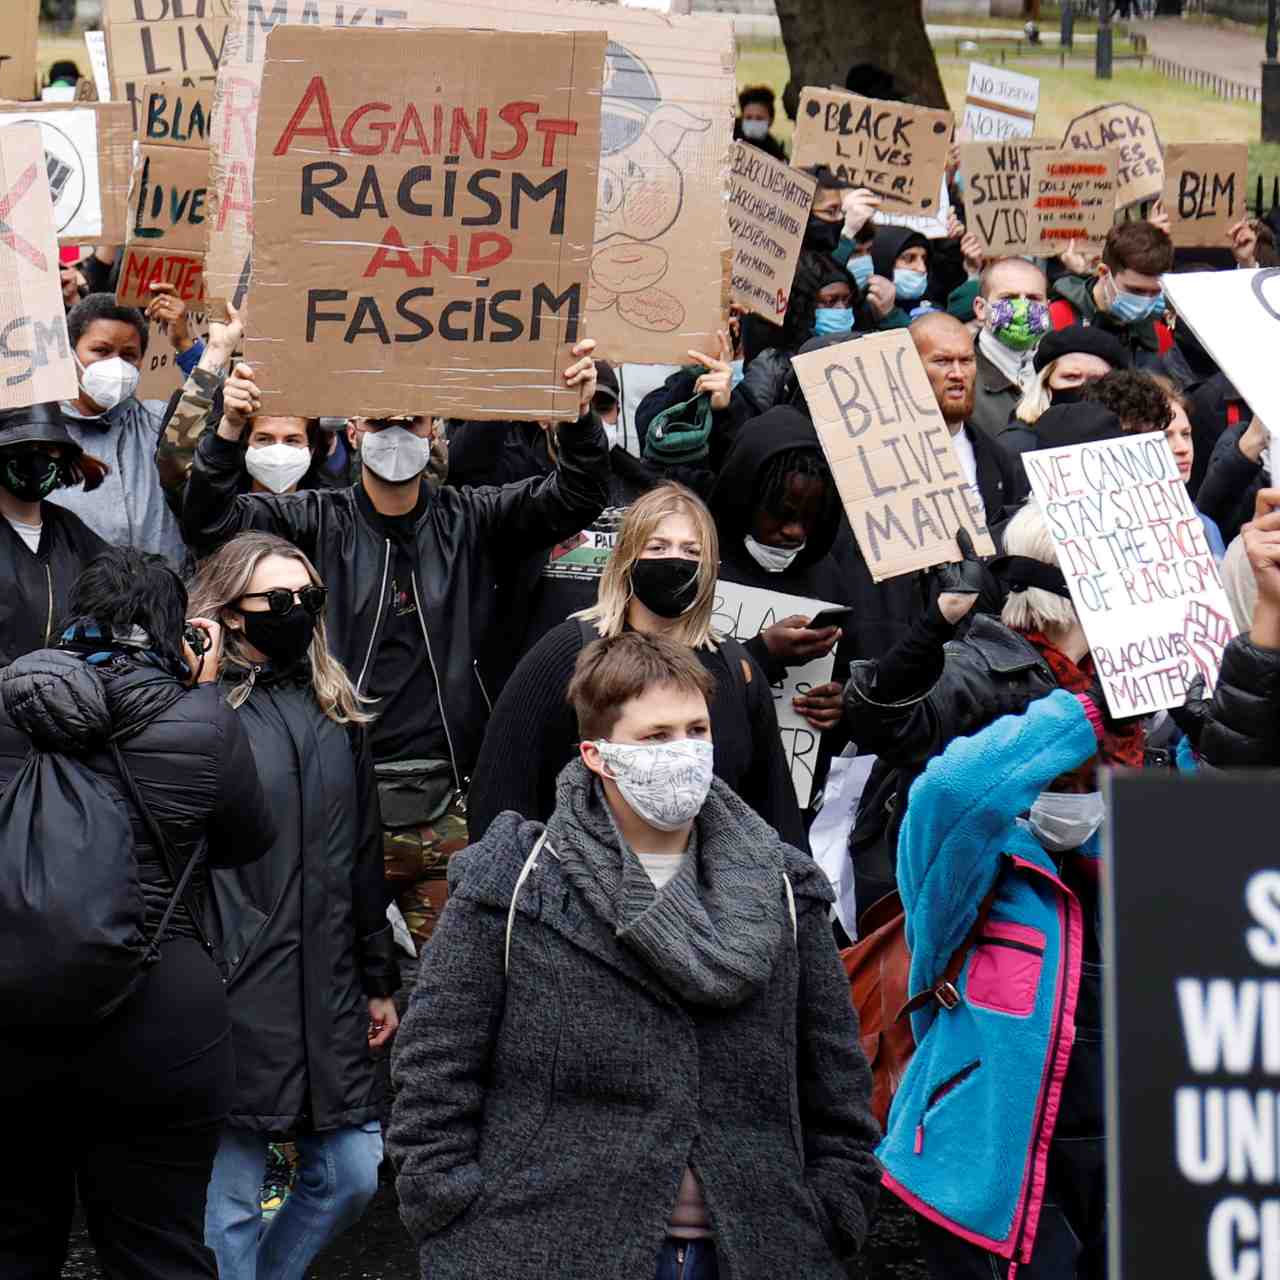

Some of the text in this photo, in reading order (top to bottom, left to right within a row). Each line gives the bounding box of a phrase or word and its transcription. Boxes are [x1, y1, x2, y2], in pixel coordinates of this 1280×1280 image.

[140, 24, 230, 75] LIV
[970, 72, 995, 96] NO
[147, 93, 212, 141] BLA
[272, 75, 580, 168] AGAINST
[824, 102, 915, 148] BLACK
[965, 110, 990, 136] NO
[1071, 117, 1146, 152] BLACK
[299, 154, 569, 236] RACISM
[1179, 170, 1237, 221] BLM
[362, 226, 514, 279] AND
[305, 277, 582, 345] FASCISM
[824, 346, 939, 439] BLAC
[857, 426, 960, 498] LIVE
[1030, 437, 1177, 501] WE CANNOT
[1046, 478, 1194, 541] STAY SILENT
[1059, 519, 1209, 577] IN THE FACE
[1077, 558, 1224, 612] OF RACISM
[1092, 632, 1190, 679] BLACK LIVES
[1106, 660, 1192, 711] MATTER
